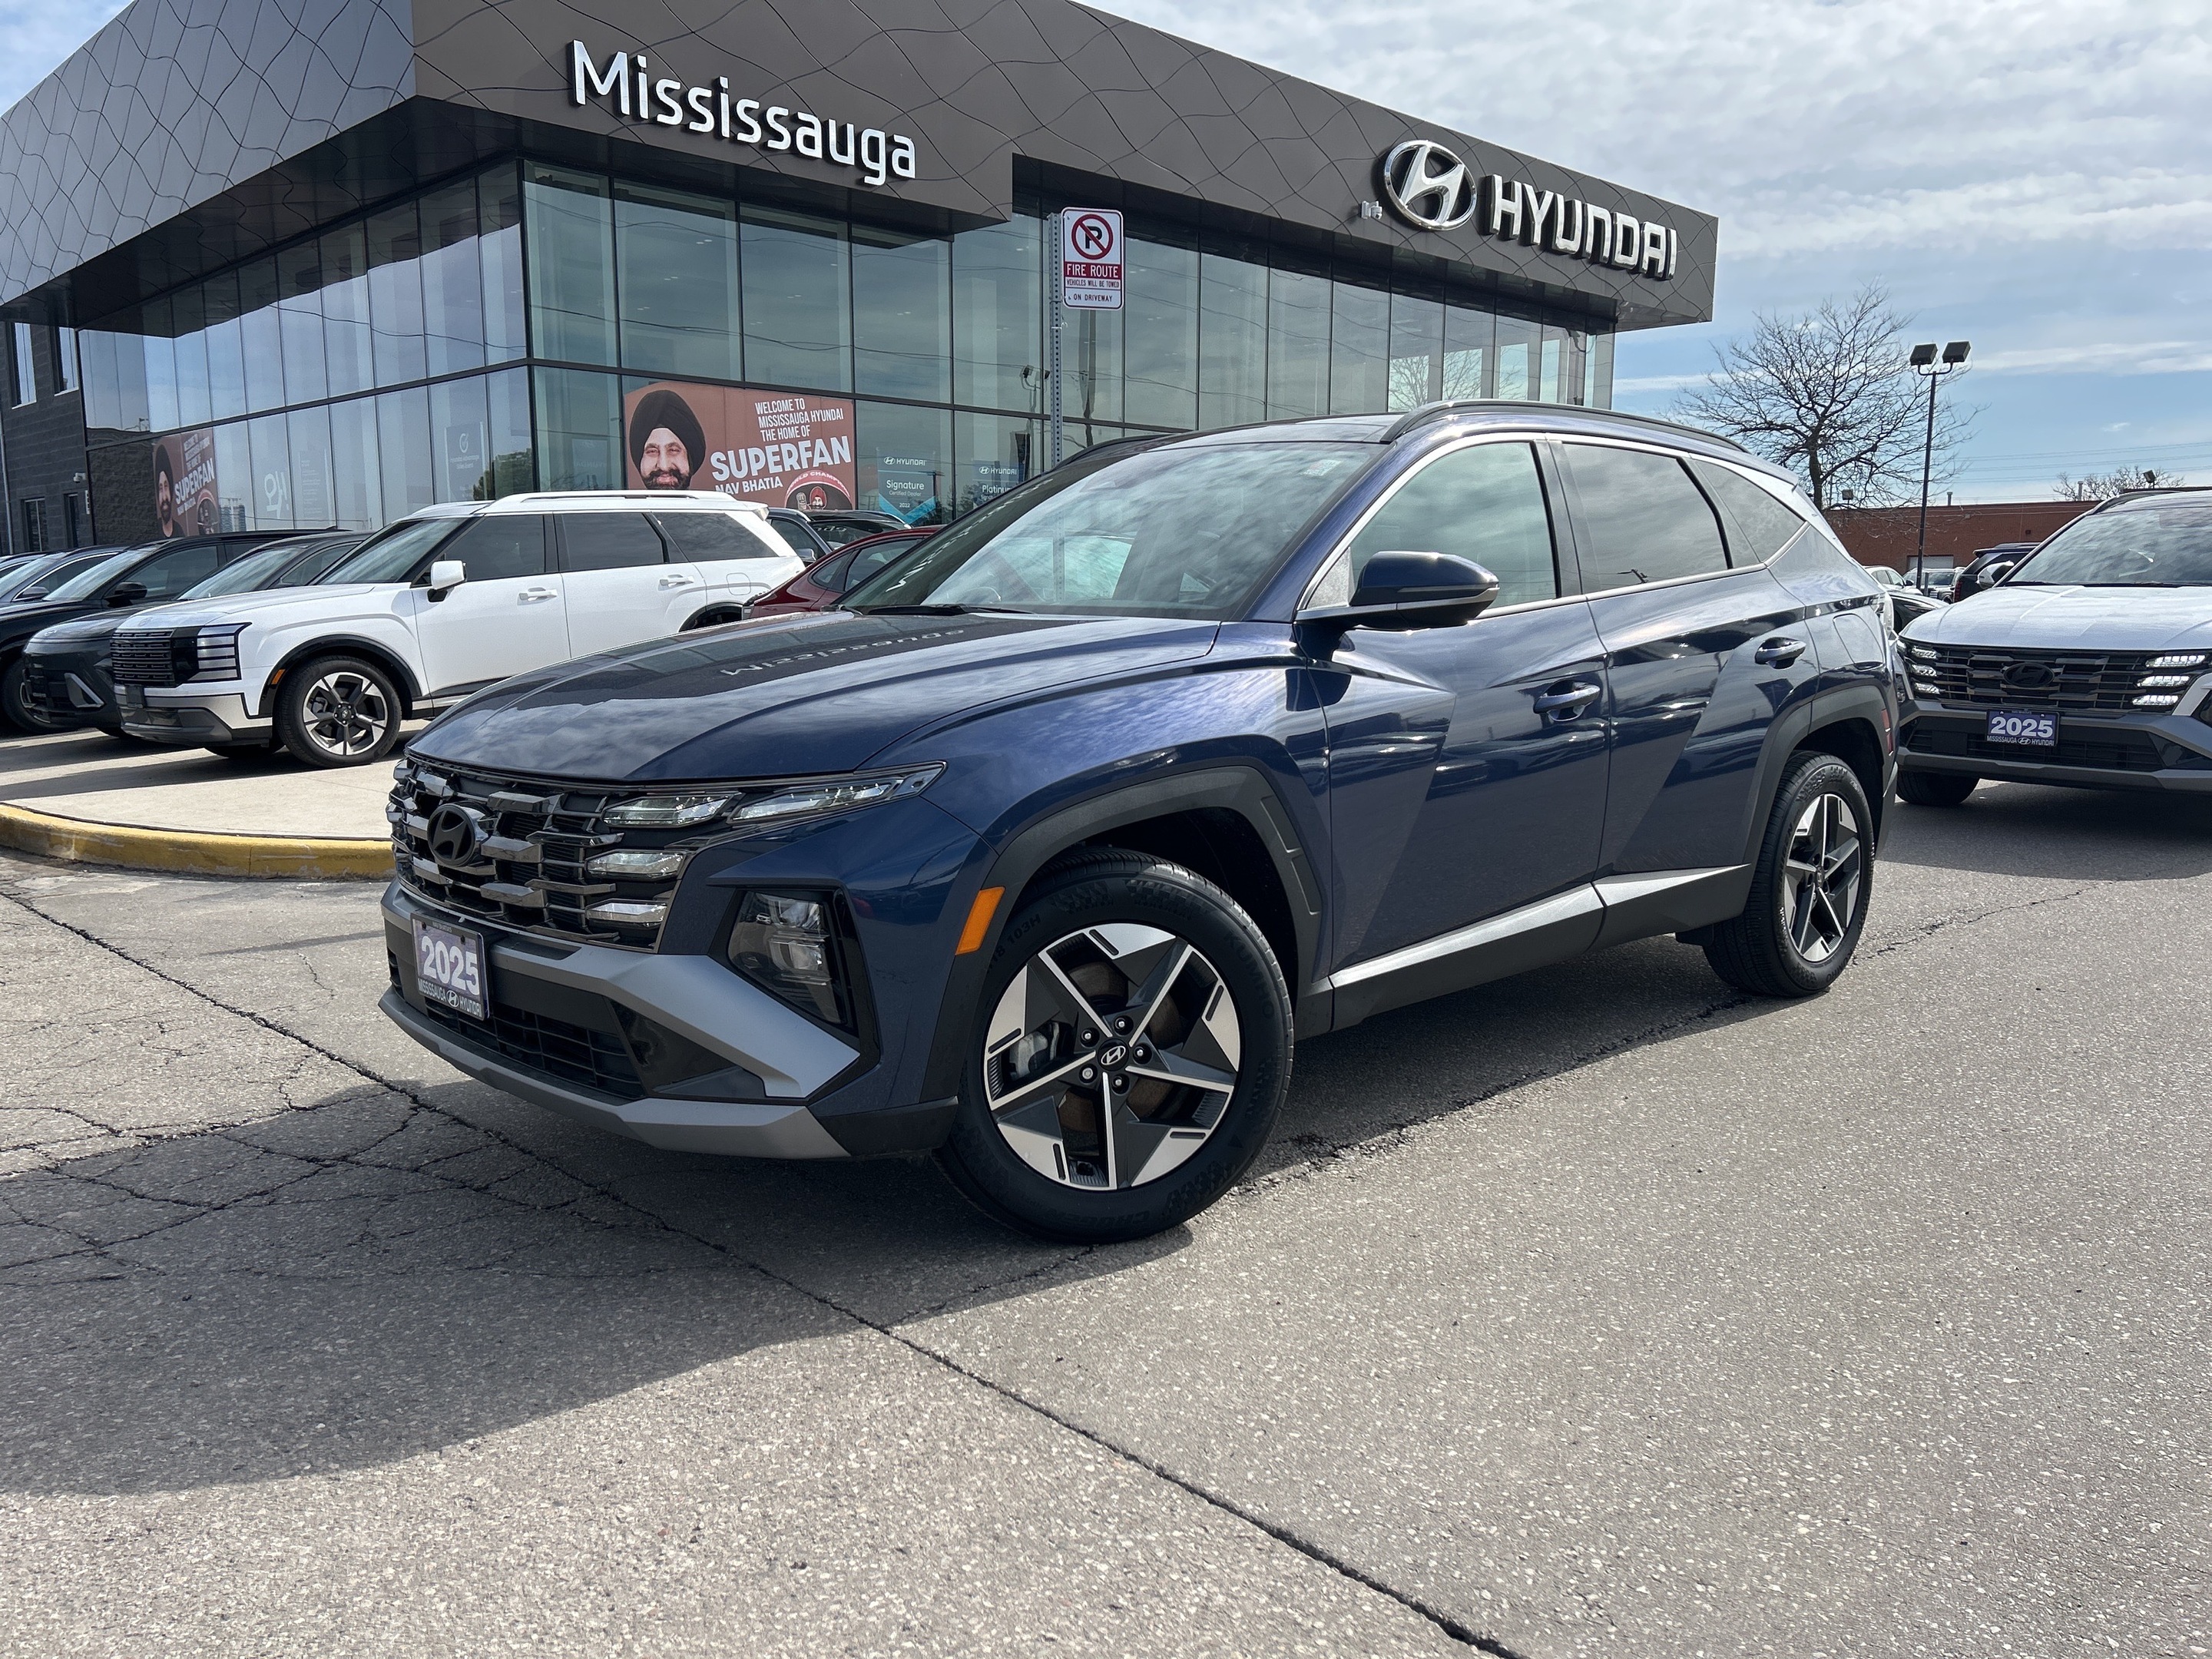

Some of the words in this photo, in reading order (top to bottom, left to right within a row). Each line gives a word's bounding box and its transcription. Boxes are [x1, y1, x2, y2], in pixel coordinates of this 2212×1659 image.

[570, 38, 916, 186] Mississauga
[1487, 174, 1677, 280] HYUNDAI
[1067, 263, 1087, 276] FIRE
[1091, 265, 1119, 278] ROUTE
[755, 399, 794, 415] WELCOME
[794, 398, 806, 410] TO
[758, 411, 810, 429] MISSISSAUGA
[810, 408, 844, 422] HYUNDAI
[760, 429, 777, 442] THE
[777, 426, 800, 440] HOME
[801, 425, 810, 437] OF
[710, 435, 852, 482] SUPERFAN
[174, 457, 215, 505] SUPERFAN
[715, 482, 739, 495] NAV
[742, 476, 783, 492] BHATIA
[886, 479, 925, 491] Signature
[1990, 716, 2053, 738] 2025
[421, 935, 480, 996] 2025
[418, 978, 446, 1002] MISSISSAUGA
